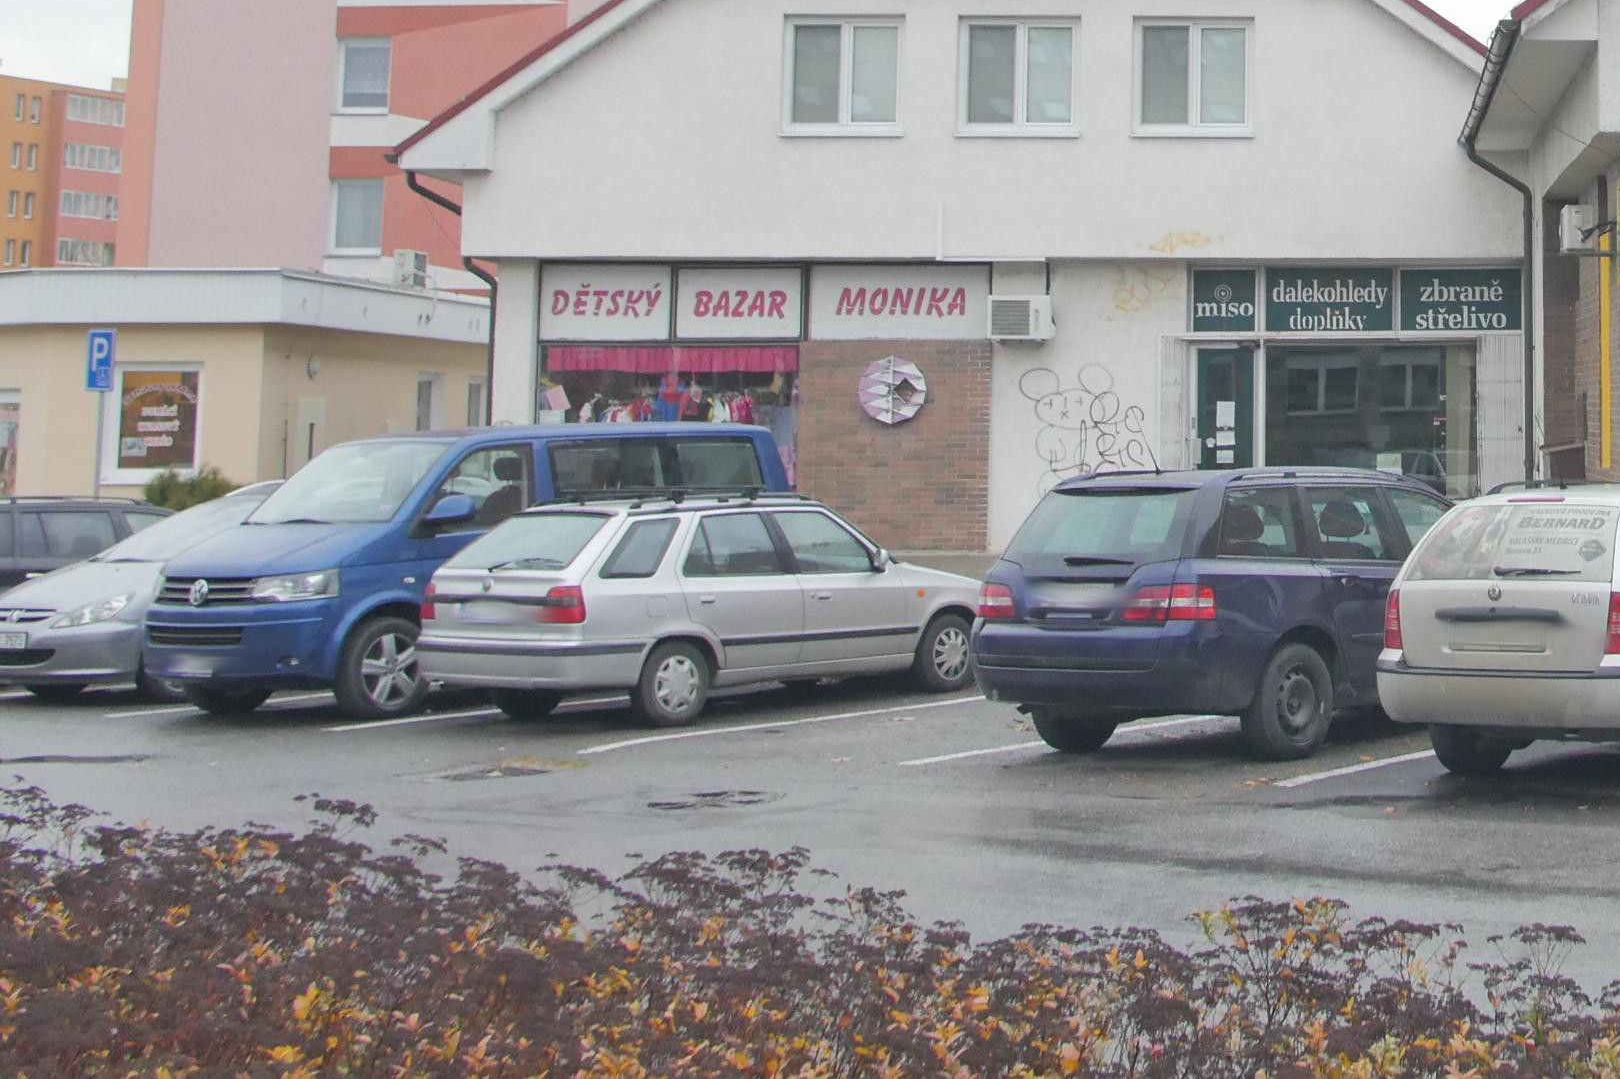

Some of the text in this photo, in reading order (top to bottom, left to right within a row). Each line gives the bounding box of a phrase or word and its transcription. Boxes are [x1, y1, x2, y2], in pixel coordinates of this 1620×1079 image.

[551, 283, 967, 319] DĚTSKÝ BAZAR MONIKA
[1272, 279, 1388, 309] dalekohledy
[1419, 279, 1504, 303] zbraně
[1195, 300, 1254, 318] miso
[1289, 308, 1367, 332] doplňky
[1415, 305, 1508, 330] střelivo
[91, 337, 109, 372] P
[1518, 516, 1607, 530] BERNARD
